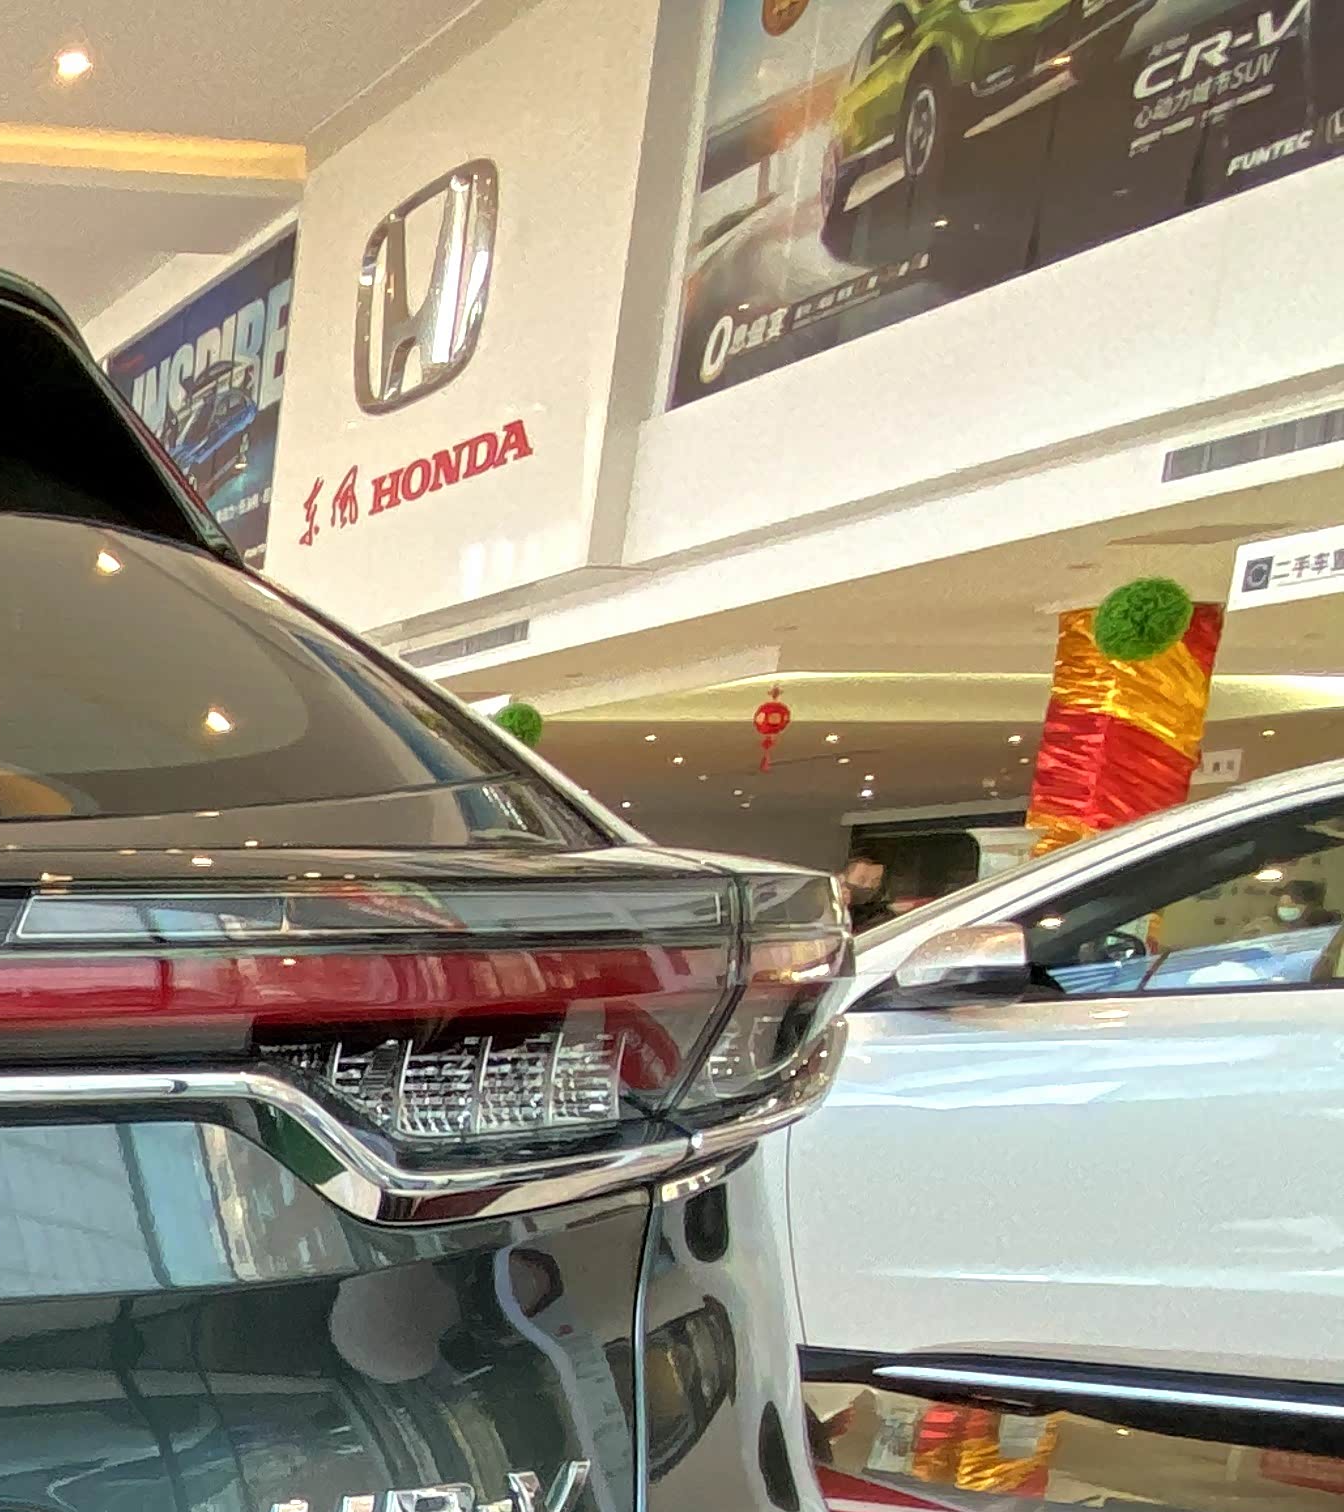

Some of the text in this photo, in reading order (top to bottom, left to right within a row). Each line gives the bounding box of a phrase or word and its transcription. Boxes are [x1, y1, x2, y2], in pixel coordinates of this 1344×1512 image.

[1133, 0, 1311, 99] CR-V
[1227, 129, 1314, 176] FUNTEC
[368, 419, 533, 515] HONDA
